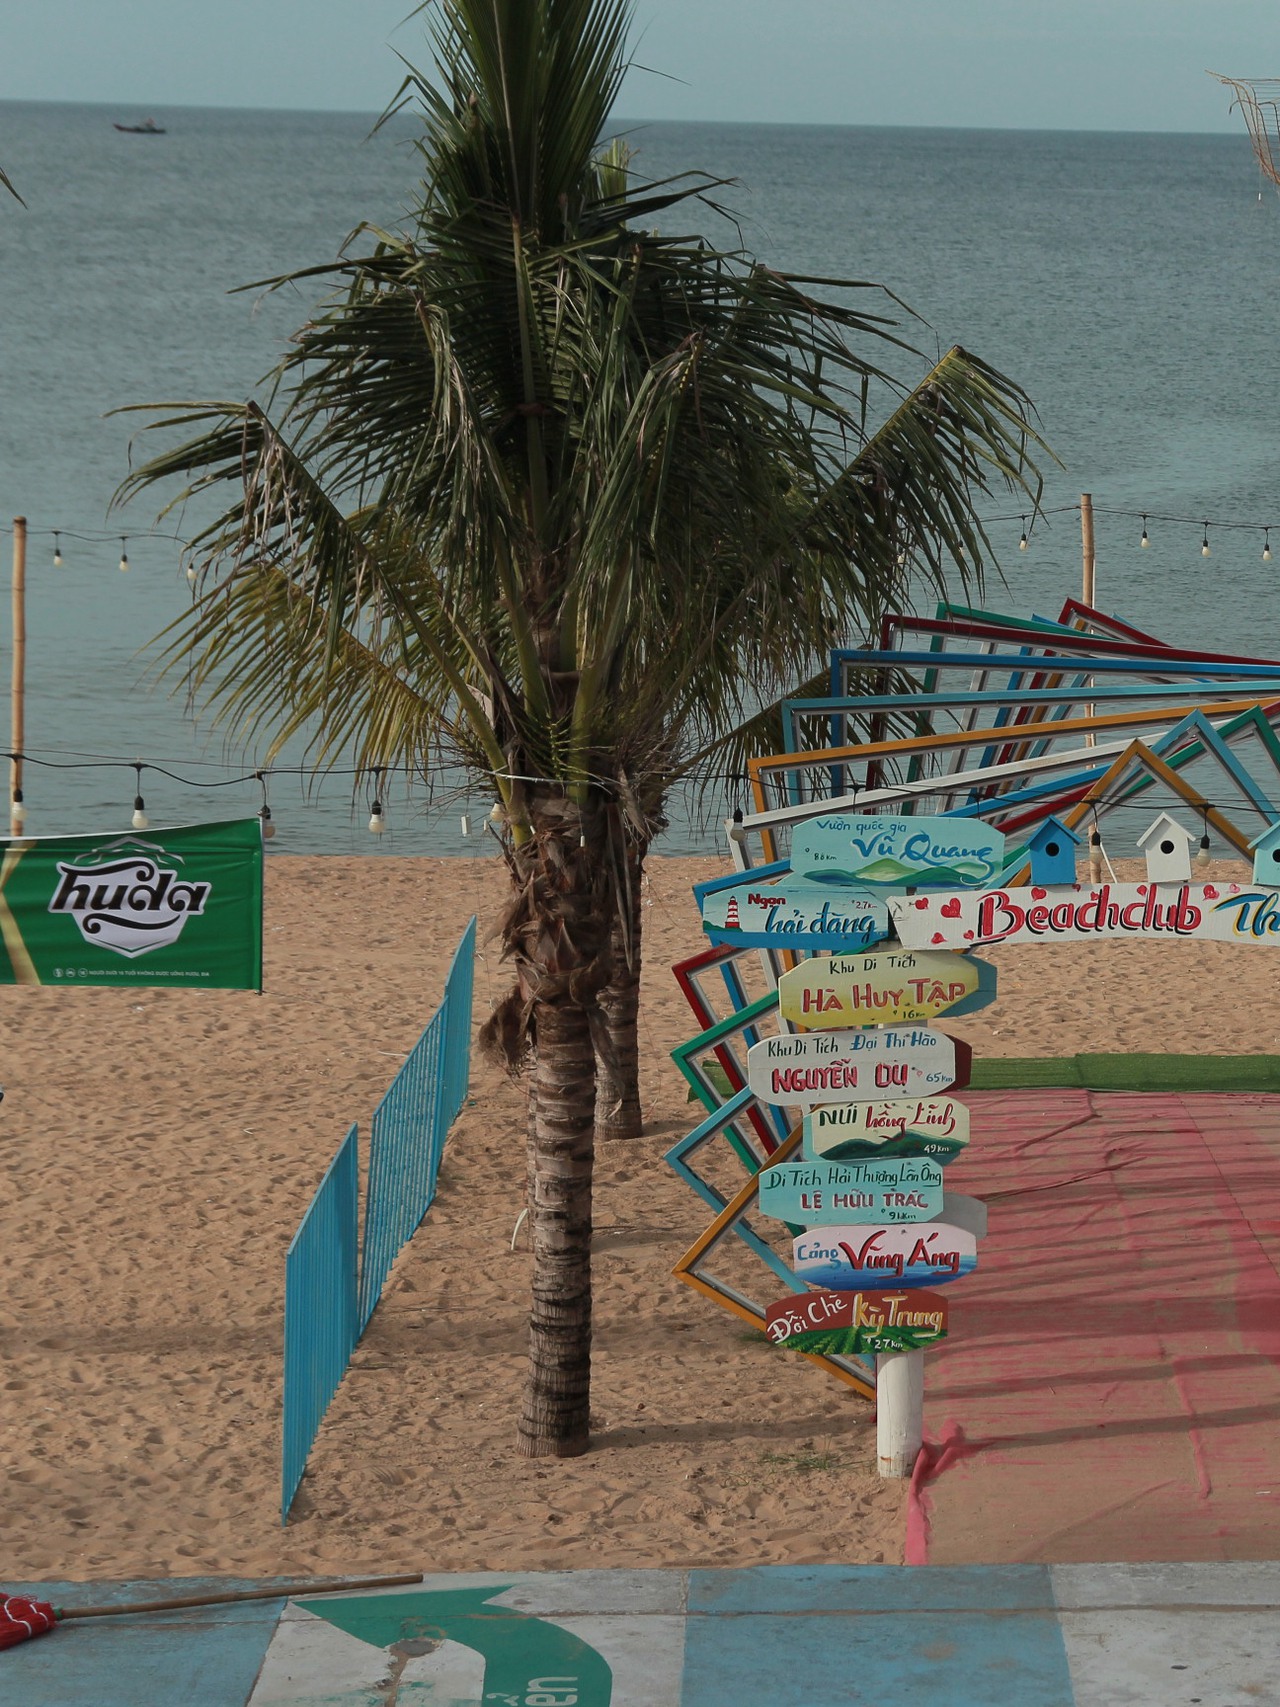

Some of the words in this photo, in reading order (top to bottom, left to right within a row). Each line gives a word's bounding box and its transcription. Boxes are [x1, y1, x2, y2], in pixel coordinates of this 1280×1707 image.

[816, 816, 851, 831] Vườn
[856, 818, 884, 836] quốc
[890, 822, 907, 837] gia
[852, 831, 896, 859] Vũ
[900, 831, 995, 884] Quang
[51, 861, 208, 912] huda
[765, 904, 807, 935] hải
[809, 901, 877, 944] đăng
[829, 960, 855, 975] Khu
[863, 958, 877, 971] Di
[887, 954, 916, 969] Tích
[802, 988, 844, 1013] HÀ
[852, 983, 904, 1009] HUY
[907, 978, 966, 1008] TẬP
[768, 1040, 792, 1057] Khu
[794, 1039, 807, 1056] Di
[812, 1035, 839, 1054] Tích
[850, 1034, 878, 1052] Đại
[884, 1032, 906, 1049] Thi
[910, 1031, 937, 1047] Hào
[771, 1058, 858, 1094] NGUYỄN
[874, 1062, 908, 1088] DU
[763, 1171, 786, 1190] Di
[789, 1170, 822, 1187] Tích
[828, 1166, 851, 1185] Hải
[852, 1163, 898, 1188] Thượng
[899, 1163, 919, 1183] Lãn
[920, 1162, 942, 1188] Ông
[801, 1190, 823, 1209] LÊ
[833, 1189, 874, 1209] HỮU
[882, 1190, 929, 1209] TRÁC
[797, 1242, 841, 1269] Cảng
[906, 1232, 960, 1276] Áng
[767, 1311, 808, 1344] Đồi
[807, 1294, 848, 1323] Chè
[852, 1293, 884, 1338] Kỳ
[882, 1295, 943, 1338] Trung
